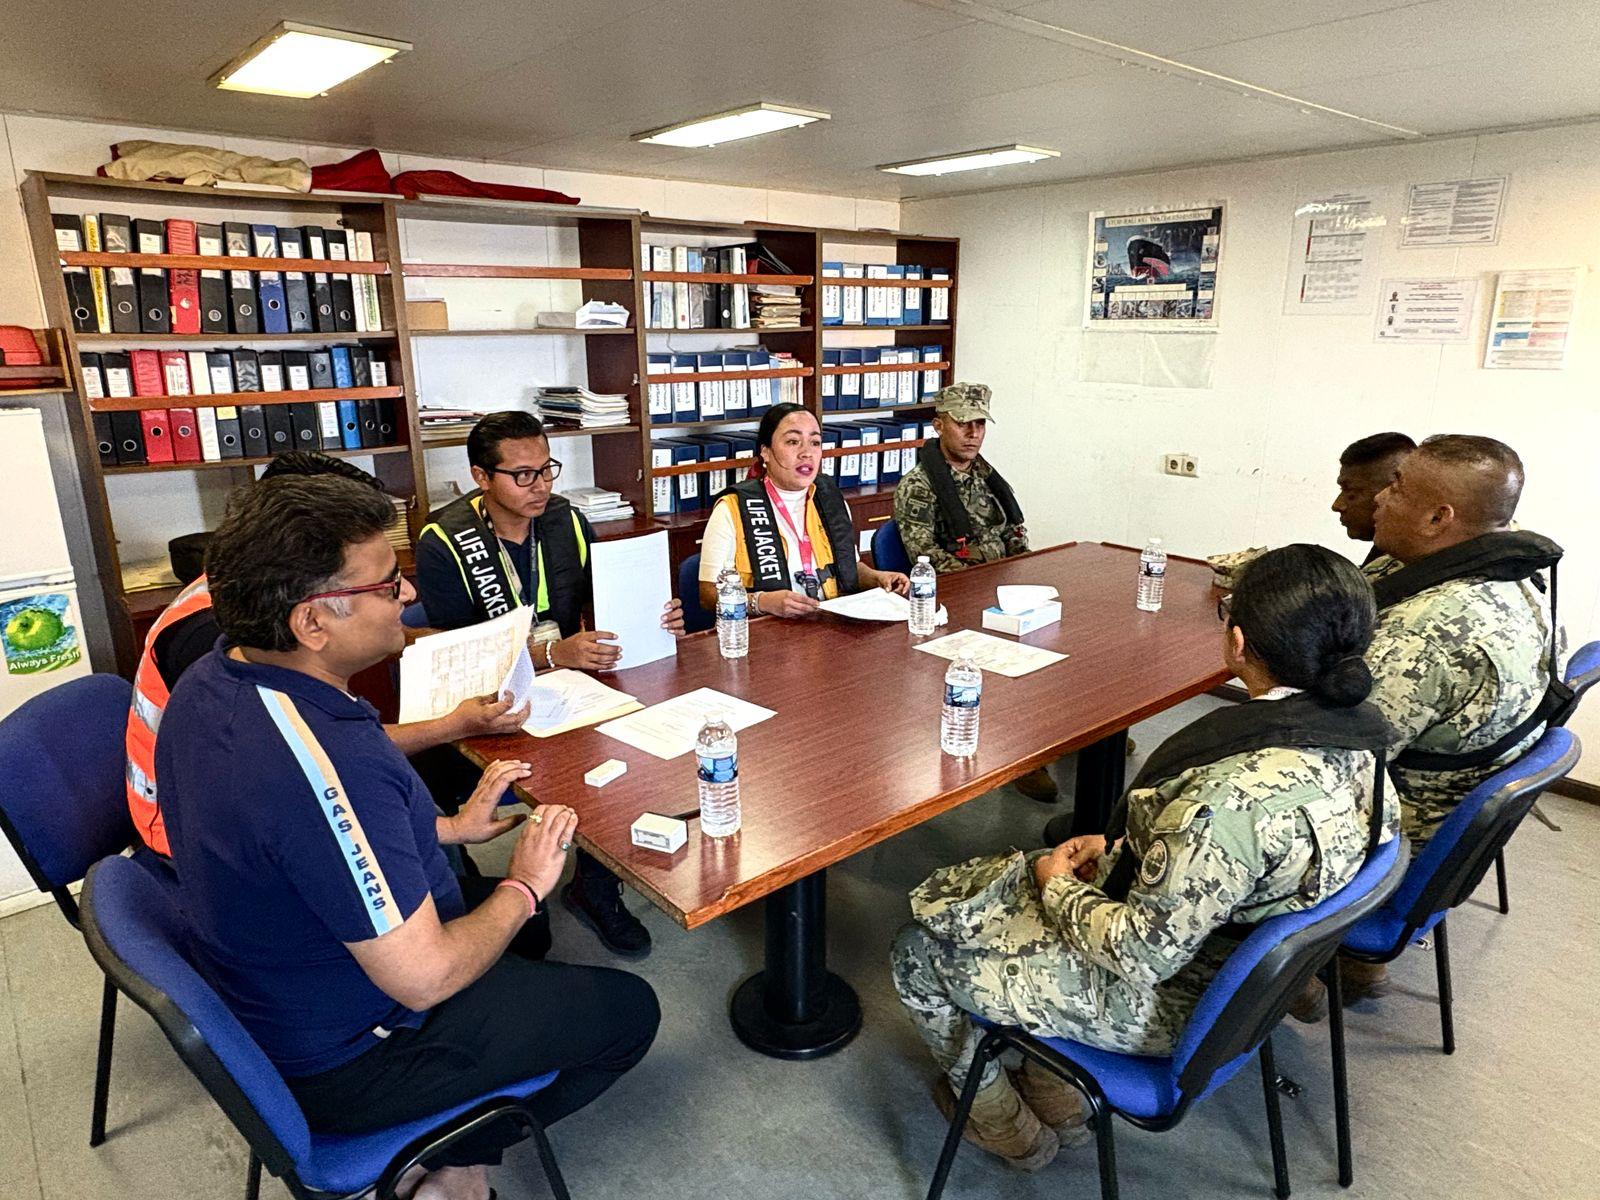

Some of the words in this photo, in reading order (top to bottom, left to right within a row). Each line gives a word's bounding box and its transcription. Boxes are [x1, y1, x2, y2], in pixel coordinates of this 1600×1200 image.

[746, 498, 770, 526] LIFE
[454, 527, 489, 566] LIFE
[753, 523, 782, 582] JACKET
[471, 565, 510, 620] JACKE
[9, 657, 48, 671] Always
[50, 651, 80, 663] Fresh
[323, 787, 353, 834] GAS
[351, 843, 386, 911] JEANS
